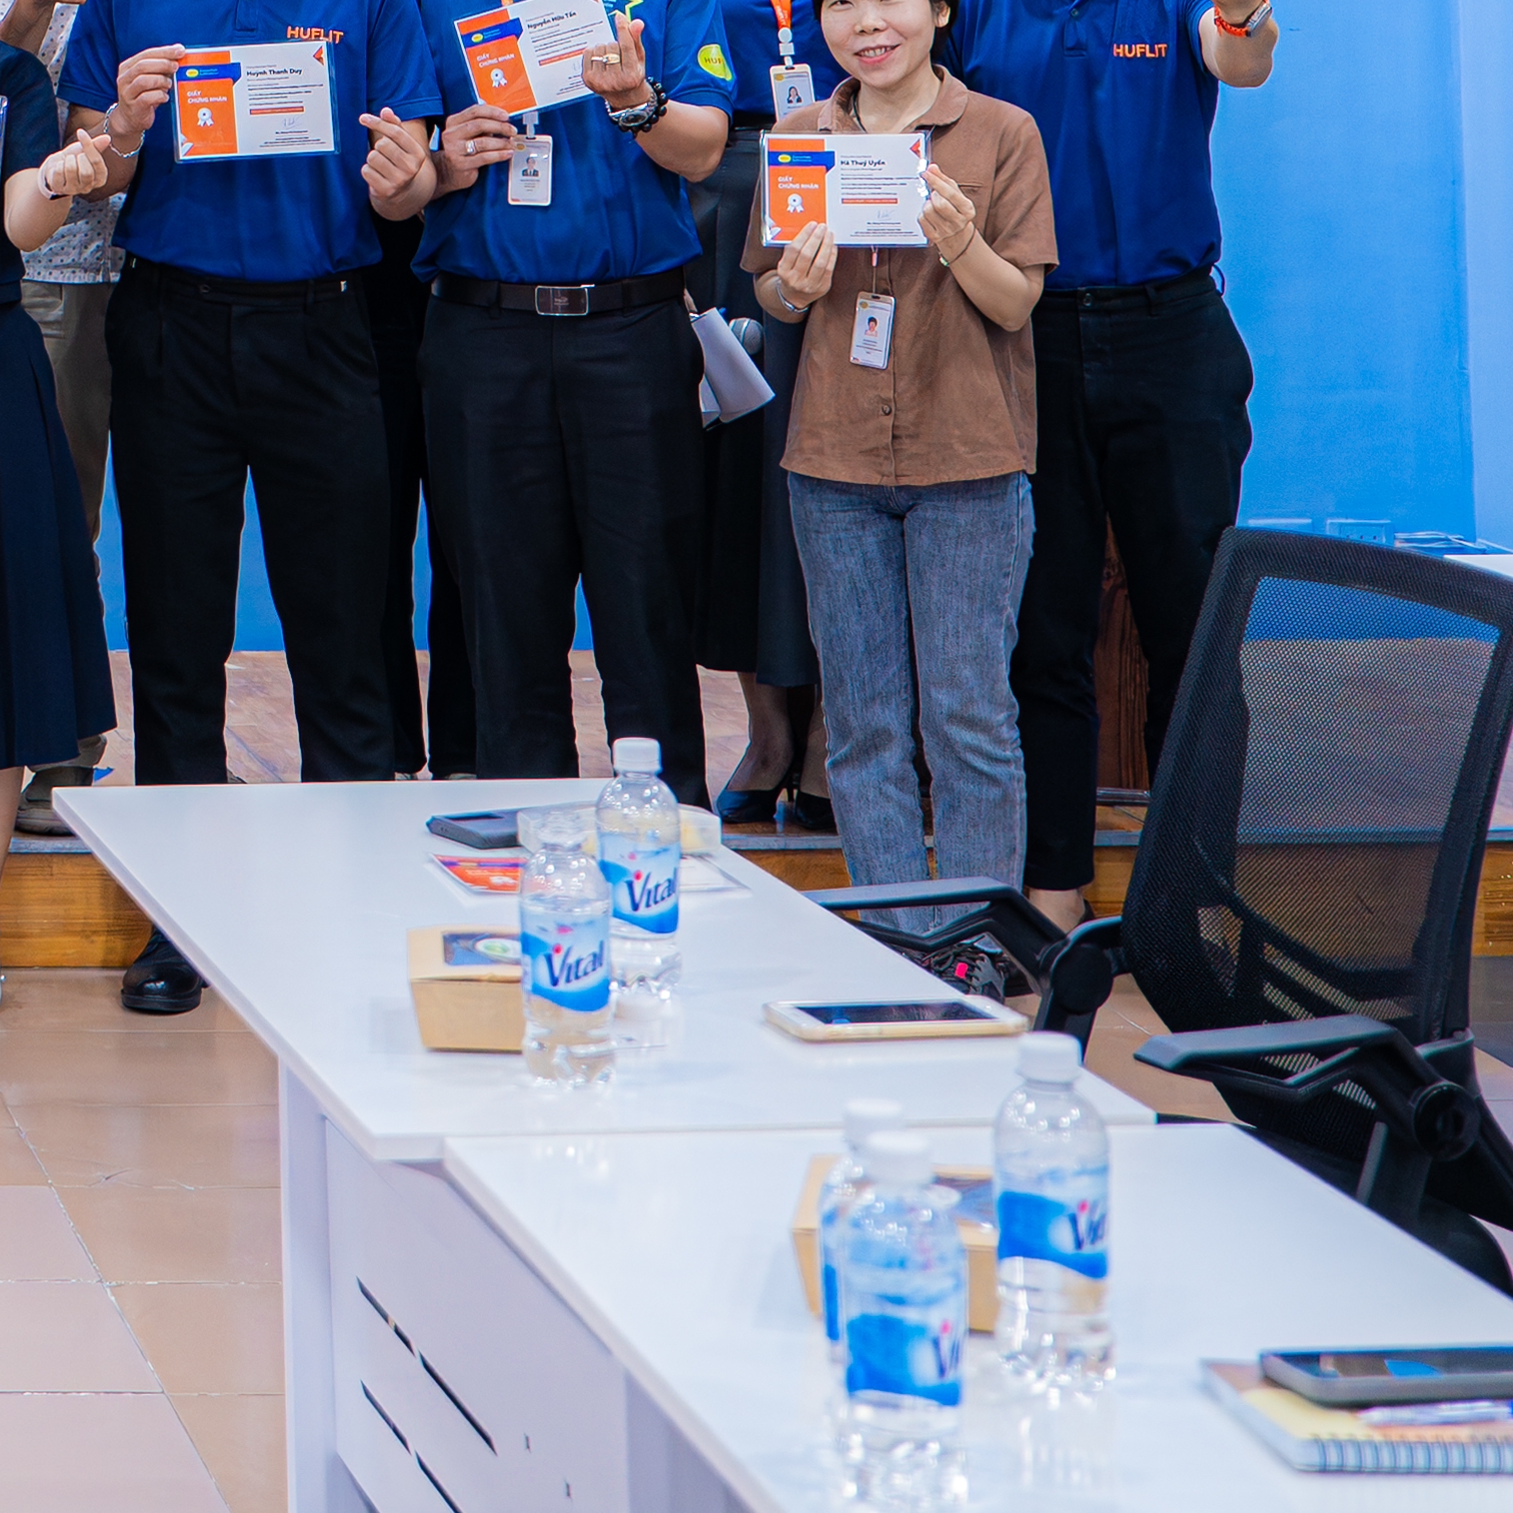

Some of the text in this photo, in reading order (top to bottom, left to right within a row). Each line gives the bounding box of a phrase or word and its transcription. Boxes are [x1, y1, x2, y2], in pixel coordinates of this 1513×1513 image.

[287, 25, 344, 44] HUFLIT
[1113, 43, 1168, 58] HUFLIT
[544, 939, 604, 988] Vital
